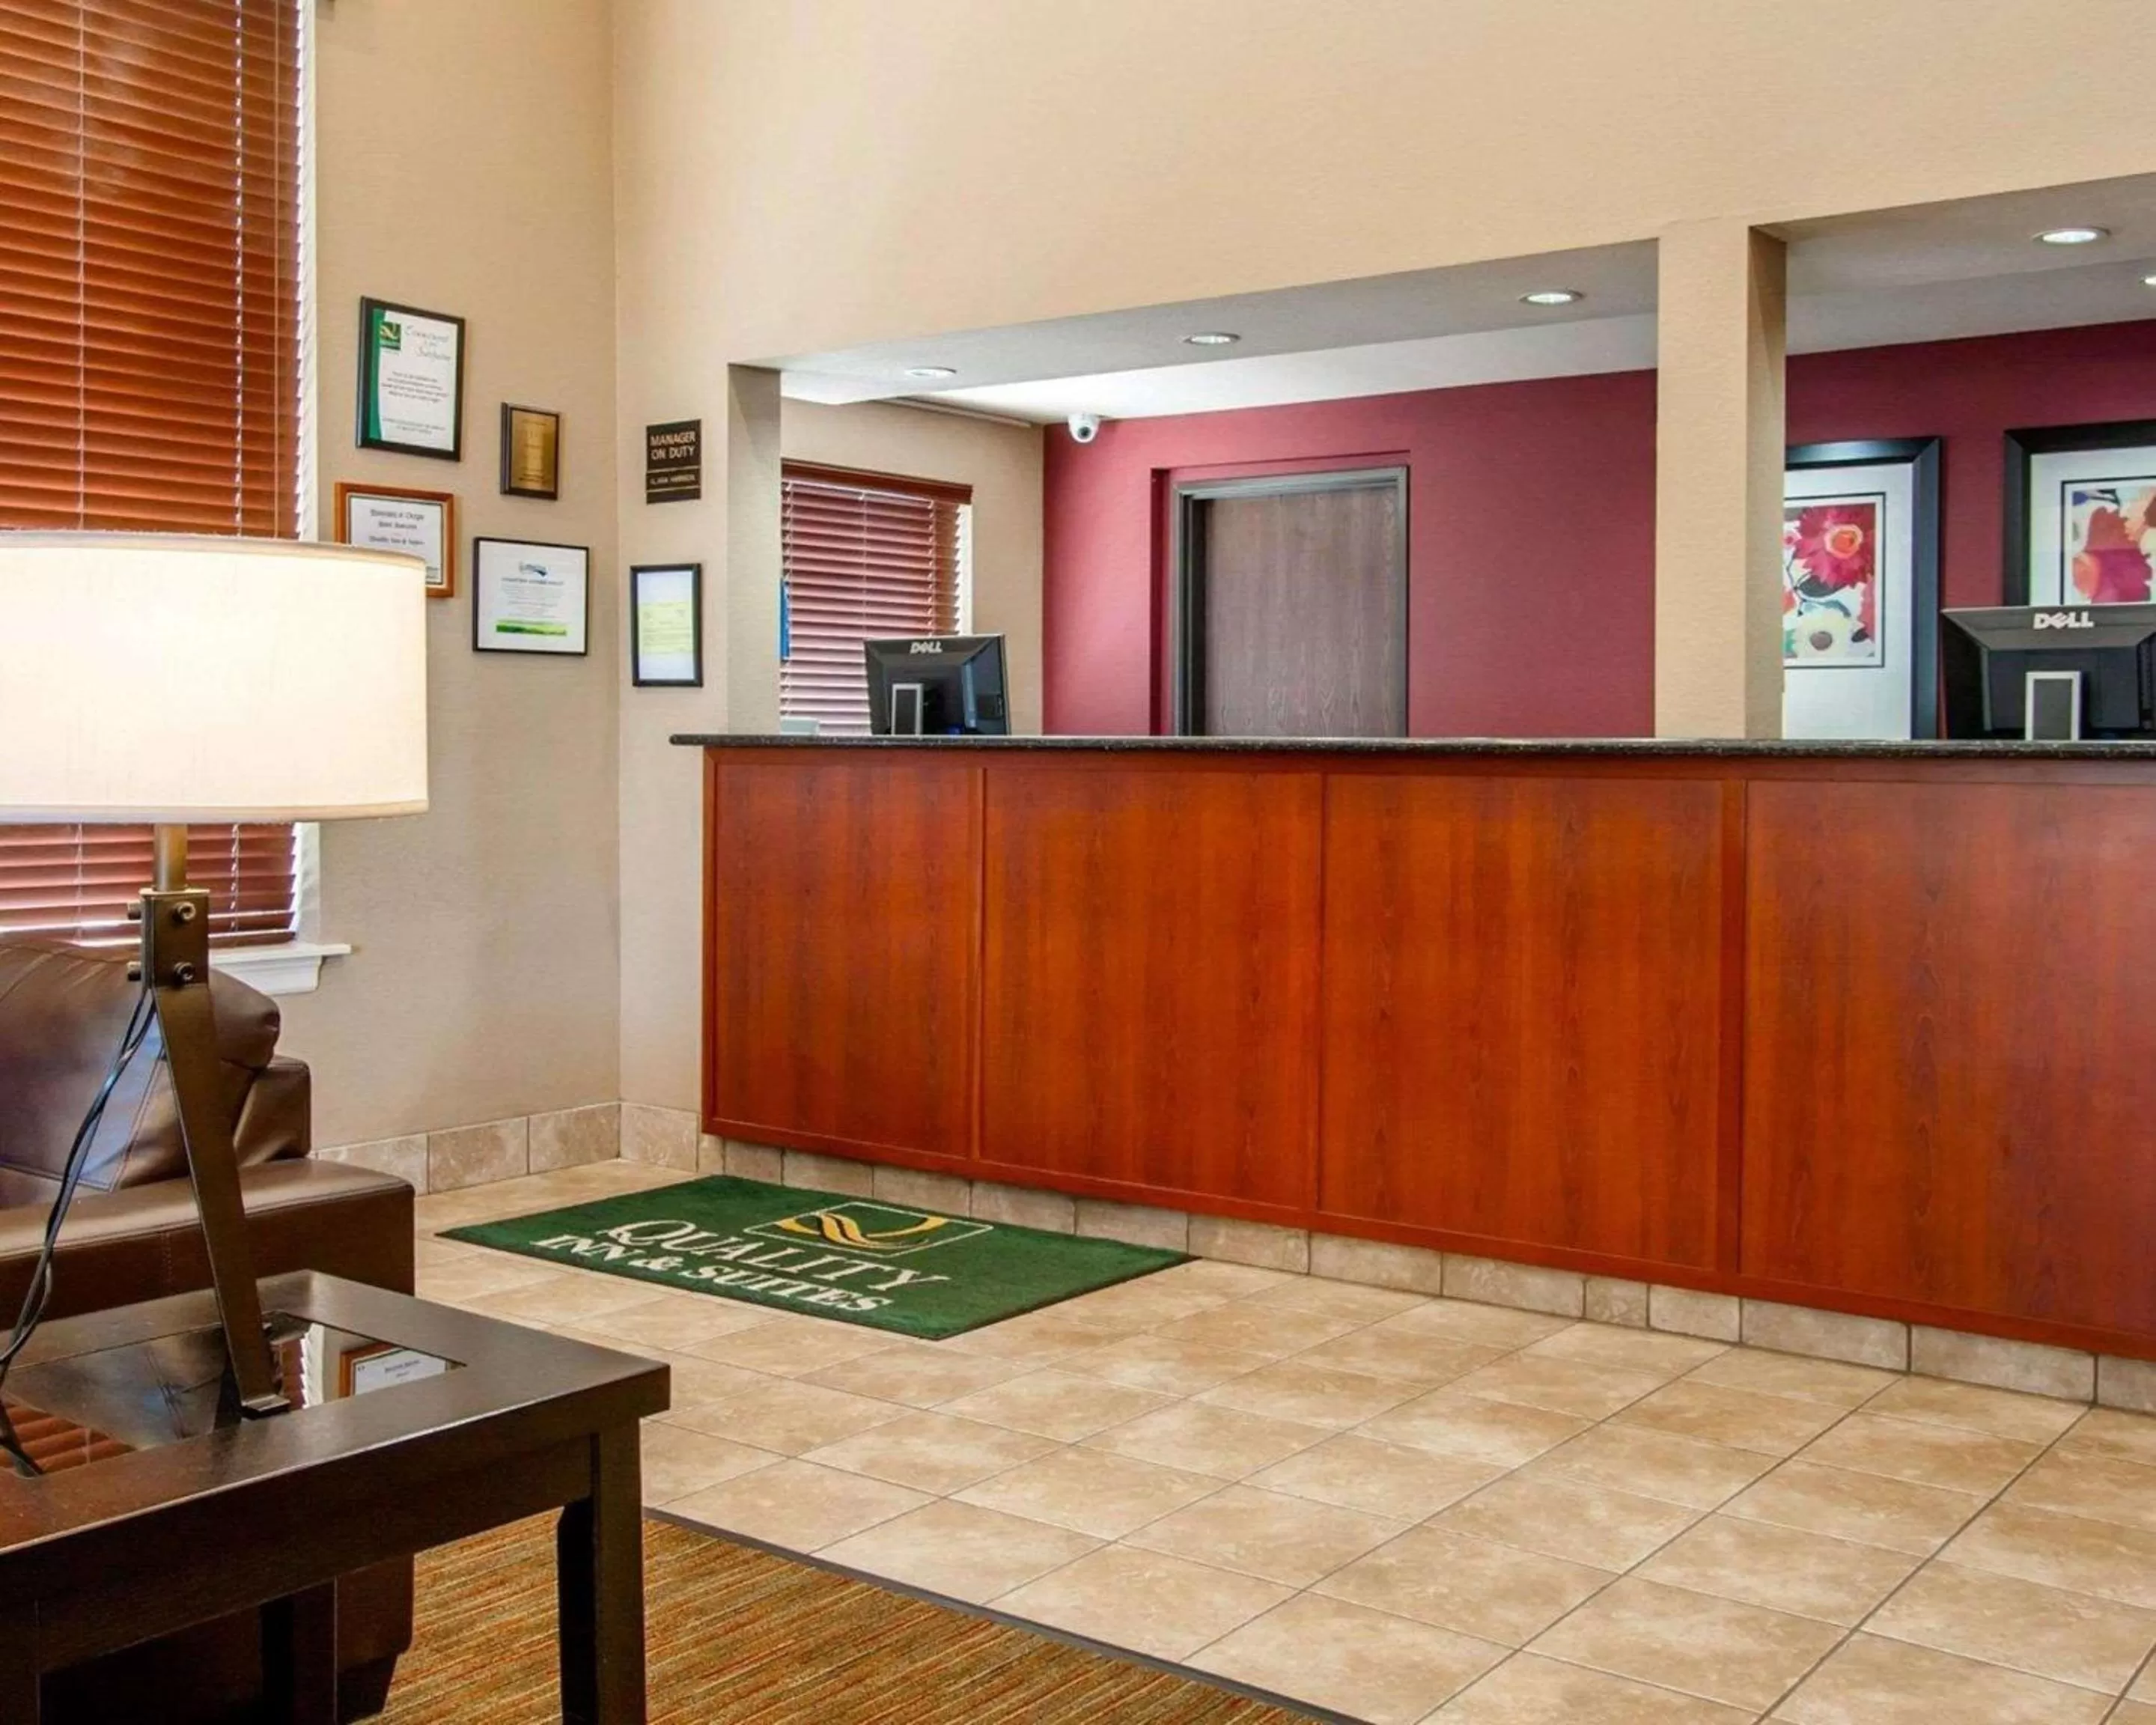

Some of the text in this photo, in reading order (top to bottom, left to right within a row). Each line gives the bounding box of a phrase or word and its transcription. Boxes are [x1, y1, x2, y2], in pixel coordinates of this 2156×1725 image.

[649, 431, 696, 446] MANAGER
[650, 445, 695, 460] ON DUTY
[2032, 611, 2094, 630] DELL
[910, 641, 943, 654] DELL
[596, 1220, 951, 1292] QUALITY
[529, 1234, 895, 1311] INN & SUITES
